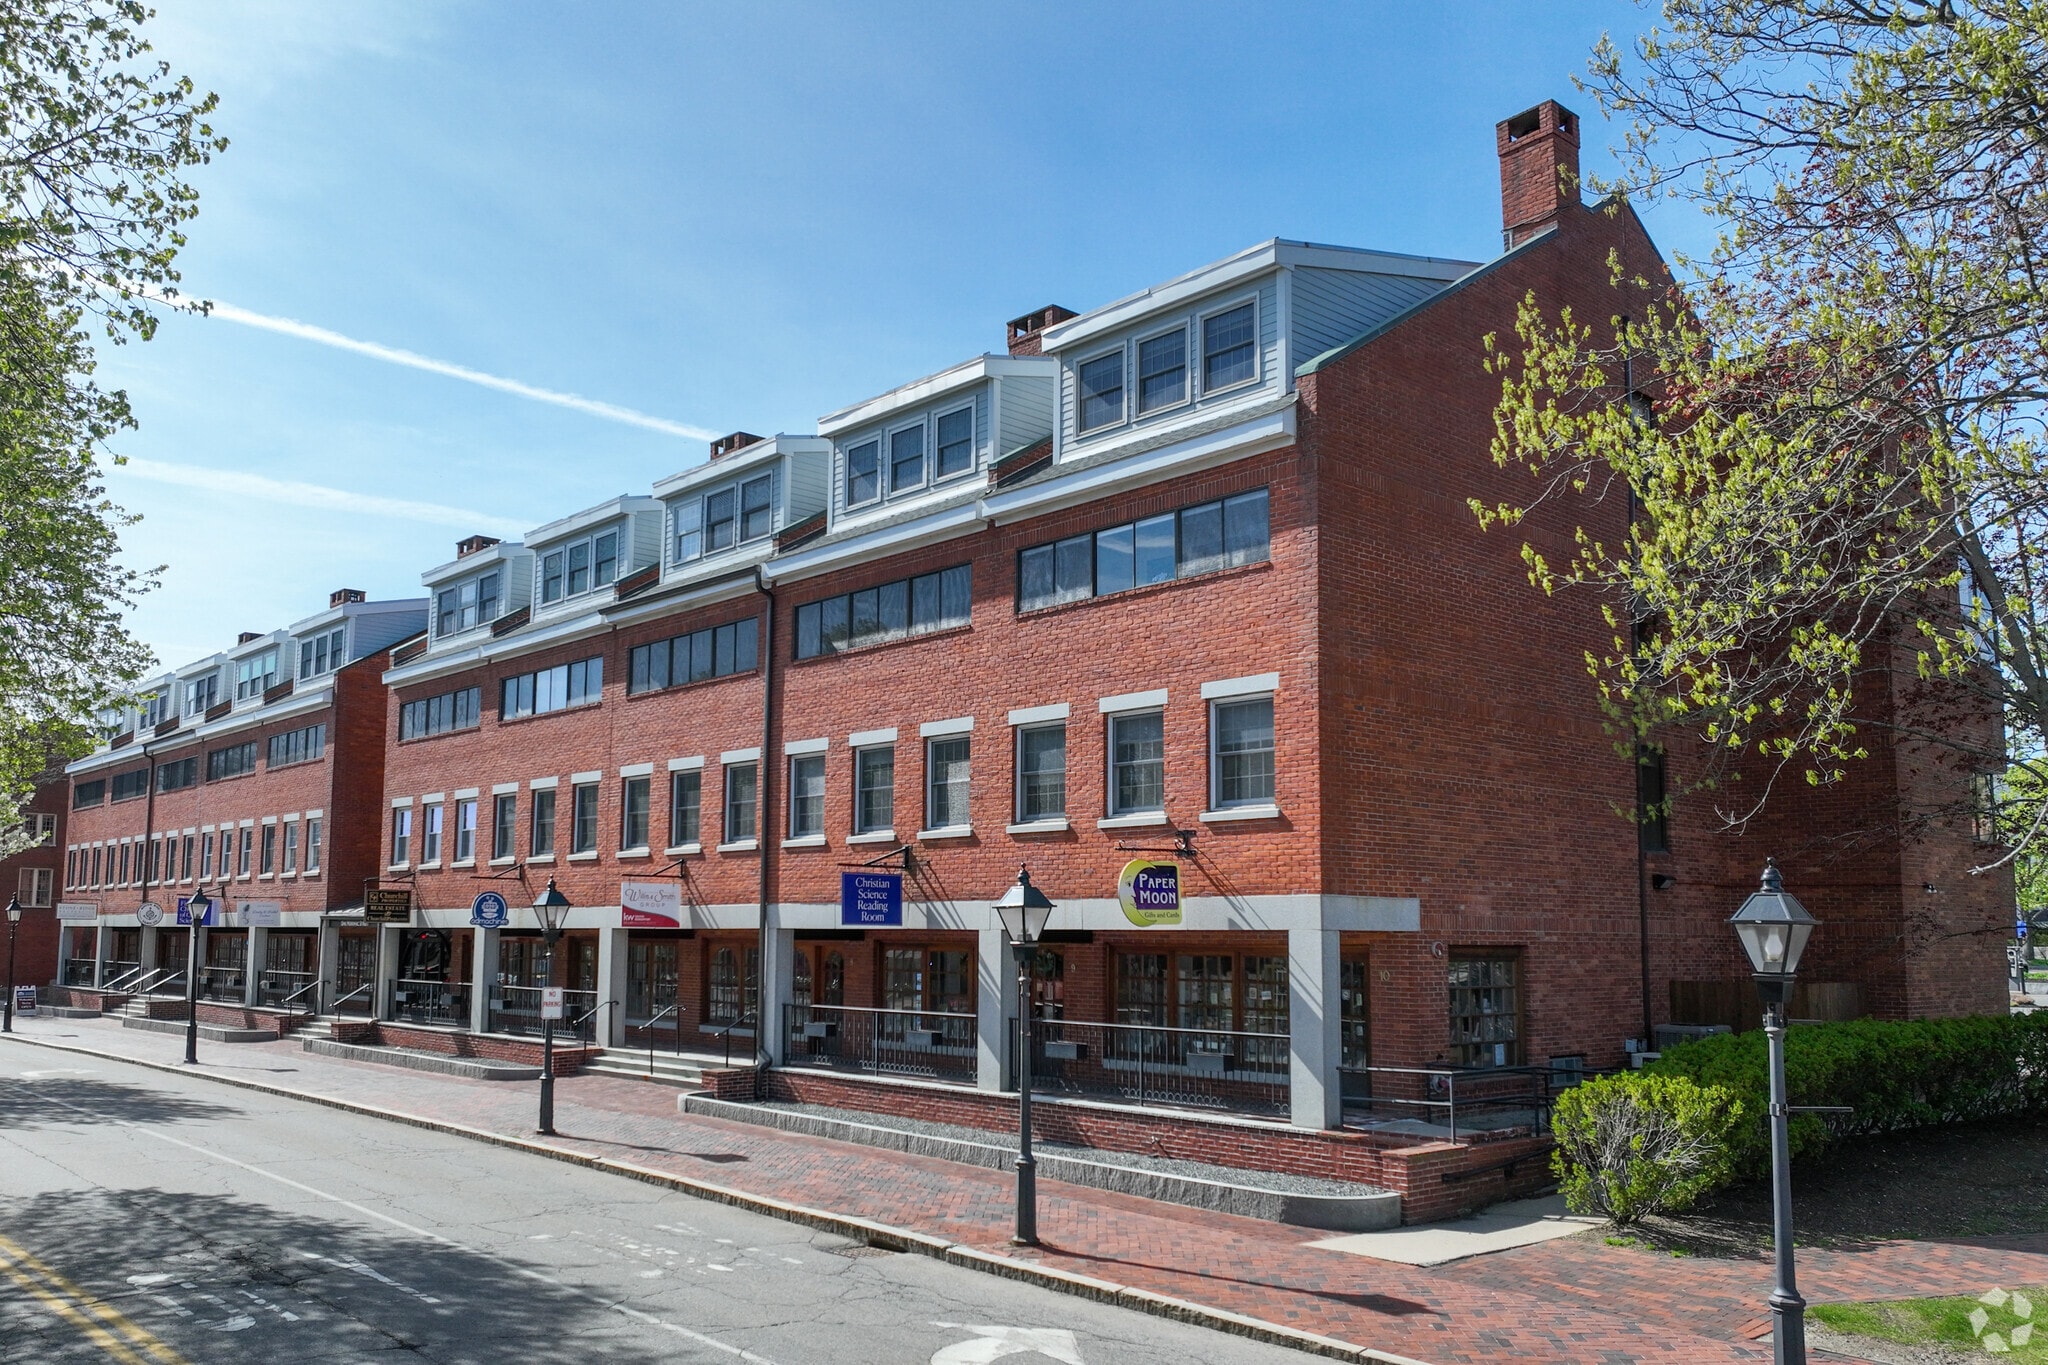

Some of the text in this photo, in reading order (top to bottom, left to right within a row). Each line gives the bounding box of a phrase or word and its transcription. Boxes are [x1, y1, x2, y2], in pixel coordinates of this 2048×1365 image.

[855, 877, 890, 888] Christian
[1139, 873, 1176, 889] PAPER
[857, 889, 888, 899] Science
[1139, 890, 1177, 904] MOON
[857, 900, 888, 913] Reading
[623, 912, 634, 921] kw
[861, 911, 885, 921] Room
[1380, 969, 1391, 982] 10
